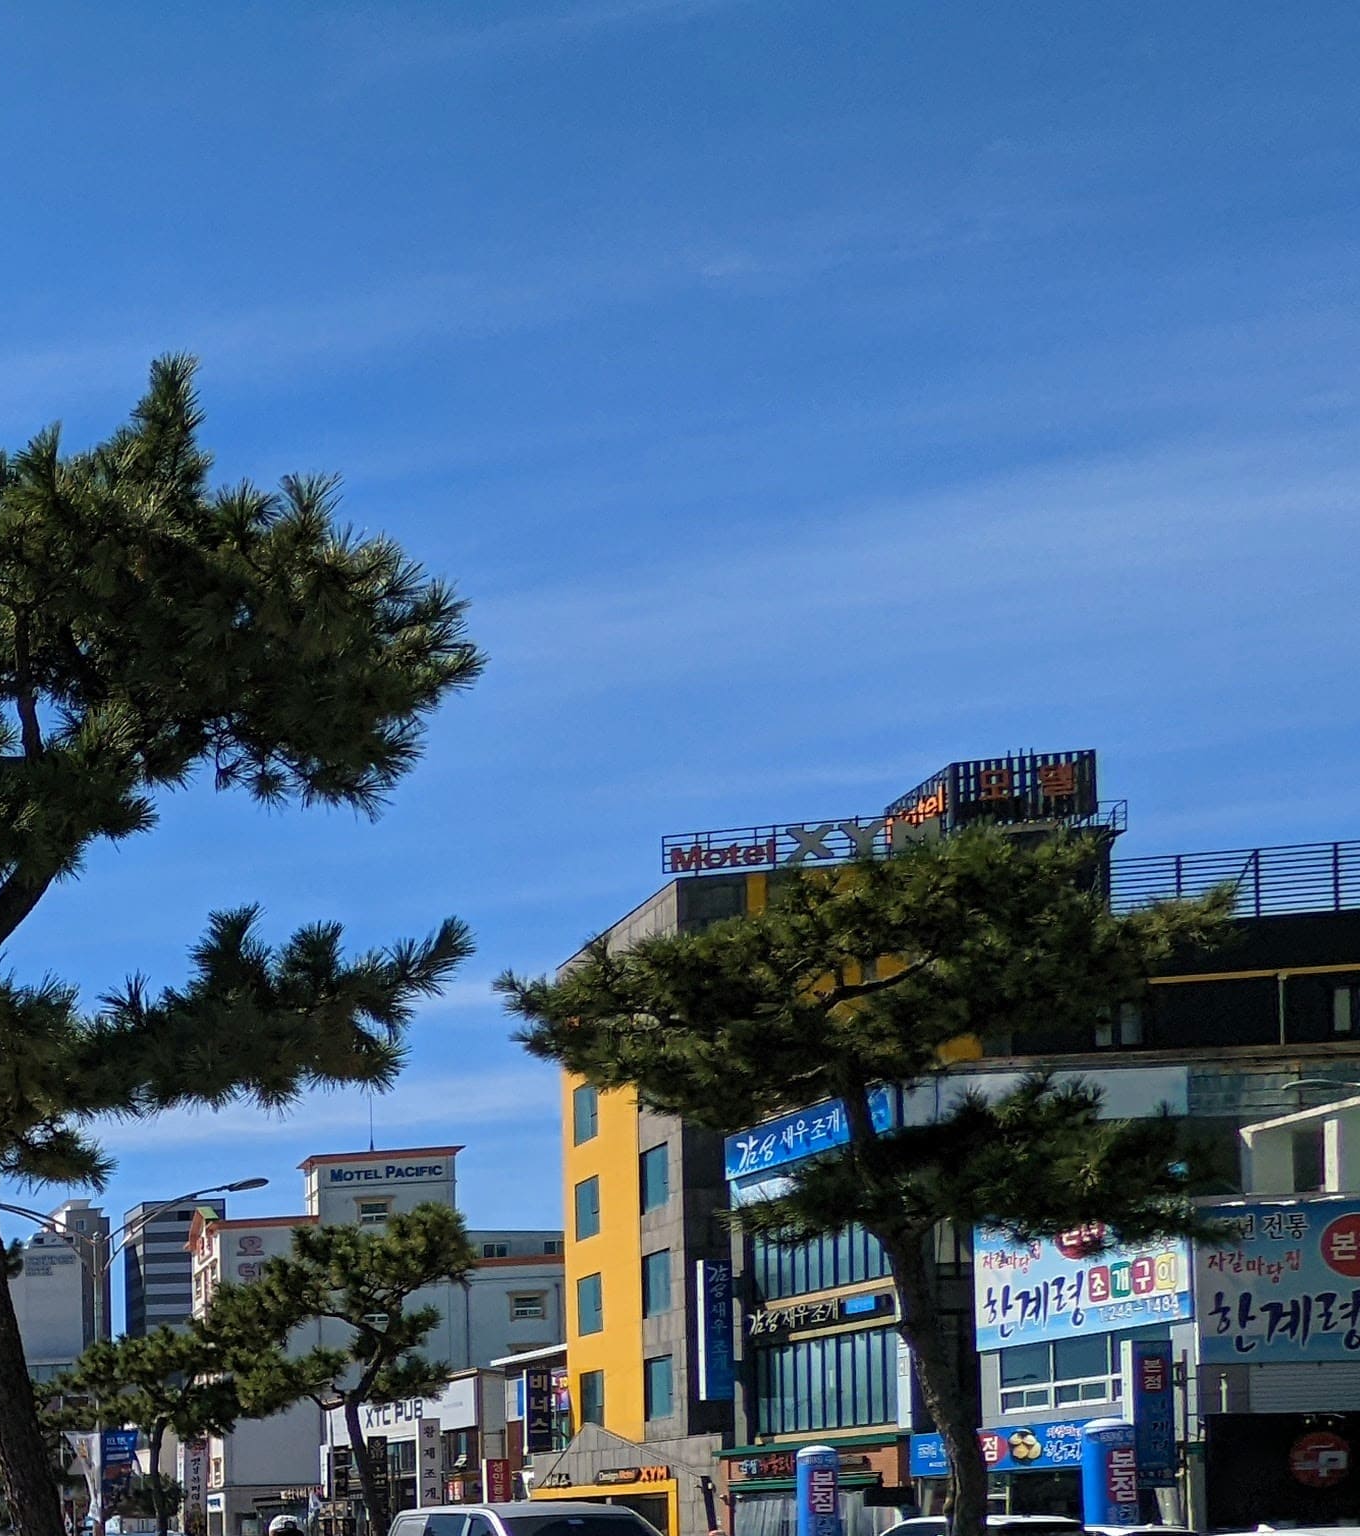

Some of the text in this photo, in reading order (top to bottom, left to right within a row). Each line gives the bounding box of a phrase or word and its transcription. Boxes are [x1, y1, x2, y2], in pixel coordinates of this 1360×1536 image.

[670, 818, 941, 872] Motel XYM
[330, 1165, 443, 1182] MOTEL PACIFIC
[1331, 1231, 1360, 1261] 본
[1088, 1256, 1177, 1299] 조개구이
[983, 1270, 1085, 1338] 한계령
[1208, 1289, 1360, 1352] 한계령
[365, 1399, 423, 1429] XTC PUB
[982, 1436, 999, 1462] 점
[640, 1465, 668, 1481] XYM
[811, 1471, 835, 1513] 본점
[1109, 1450, 1137, 1502] 본점
